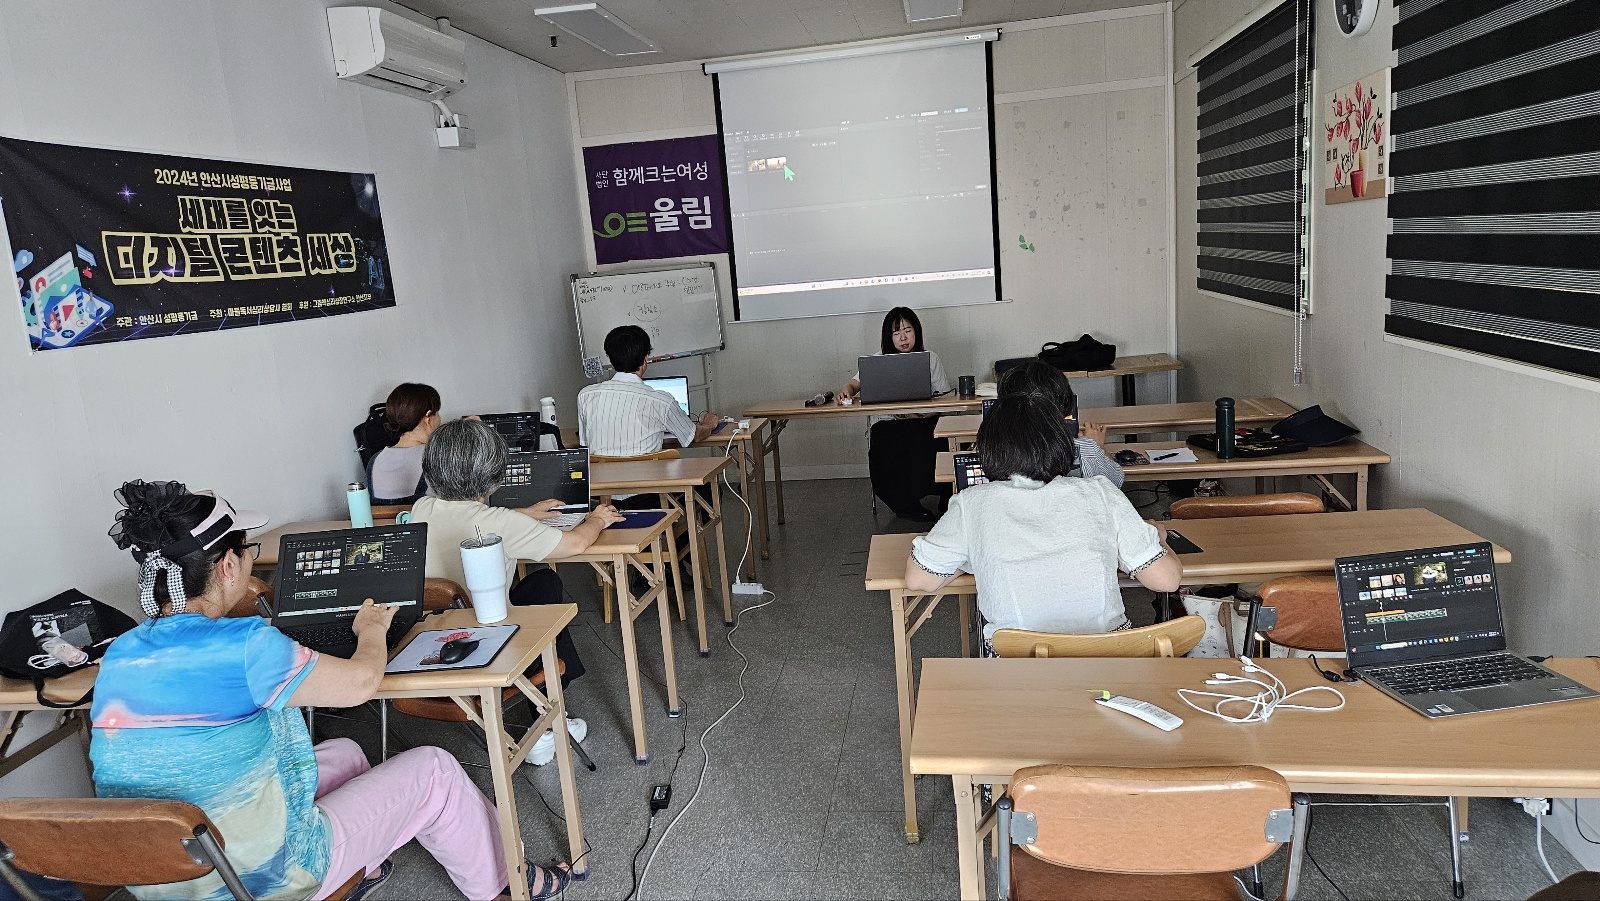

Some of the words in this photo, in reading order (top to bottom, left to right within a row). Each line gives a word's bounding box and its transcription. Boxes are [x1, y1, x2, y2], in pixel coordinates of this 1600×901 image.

[154, 168, 198, 187] 2024년
[199, 172, 293, 192] 안산시성평등기금사업
[596, 170, 608, 179] 사단
[612, 161, 708, 187] 함께크는여성
[596, 180, 609, 189] 법인
[177, 195, 252, 234] 세대를
[251, 198, 298, 233] 잇는
[102, 231, 224, 285] 디지털
[216, 233, 306, 281] 콘텐츠
[306, 233, 356, 275] 세상
[116, 316, 133, 327] 주관
[139, 314, 162, 325] 안산시
[209, 308, 222, 318] 주최
